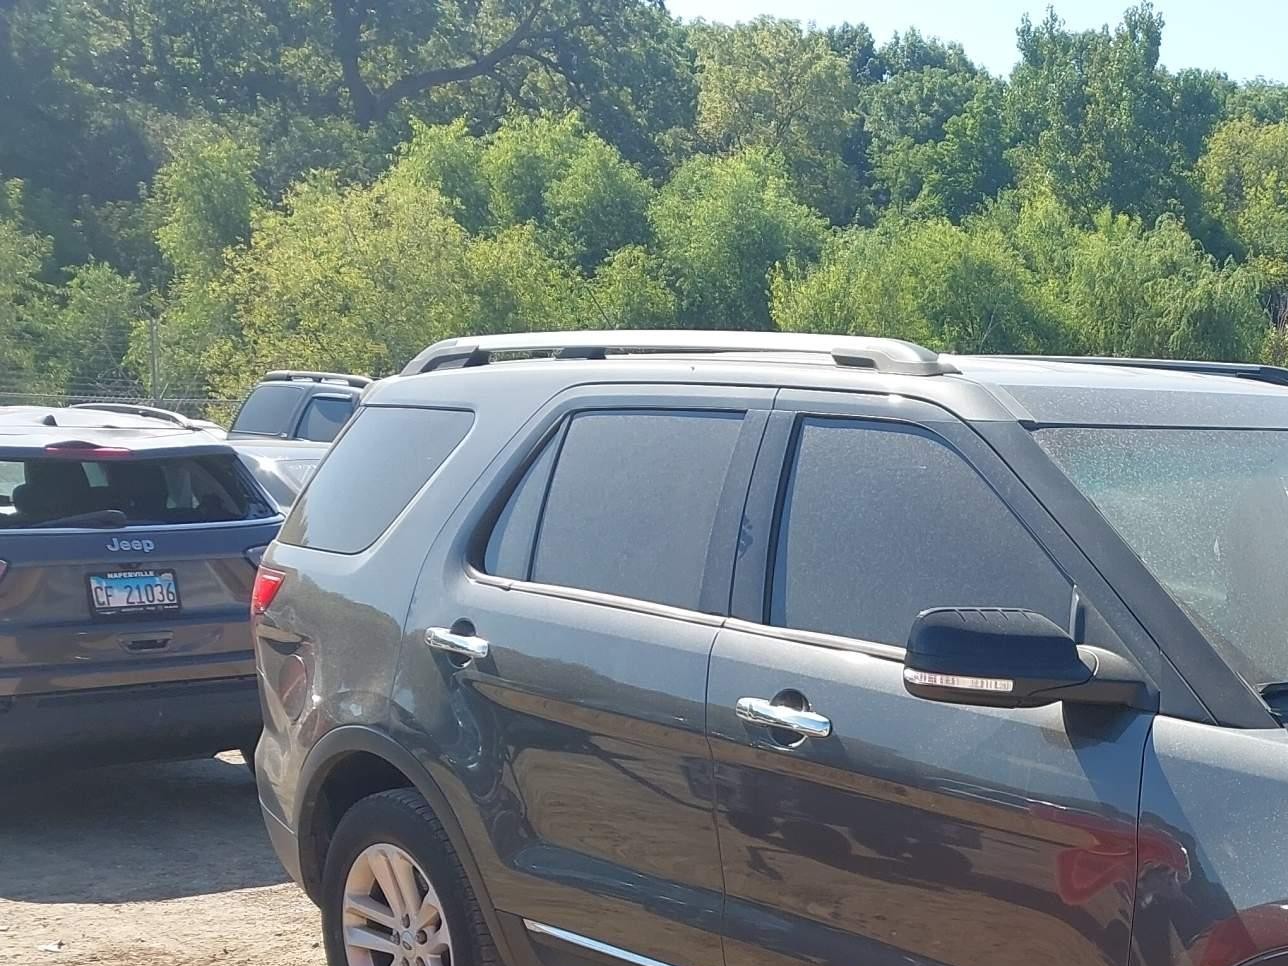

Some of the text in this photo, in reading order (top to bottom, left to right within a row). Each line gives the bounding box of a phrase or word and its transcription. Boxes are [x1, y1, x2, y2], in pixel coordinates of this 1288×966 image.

[106, 538, 154, 552] Jeep
[94, 583, 175, 606] CF 21036
